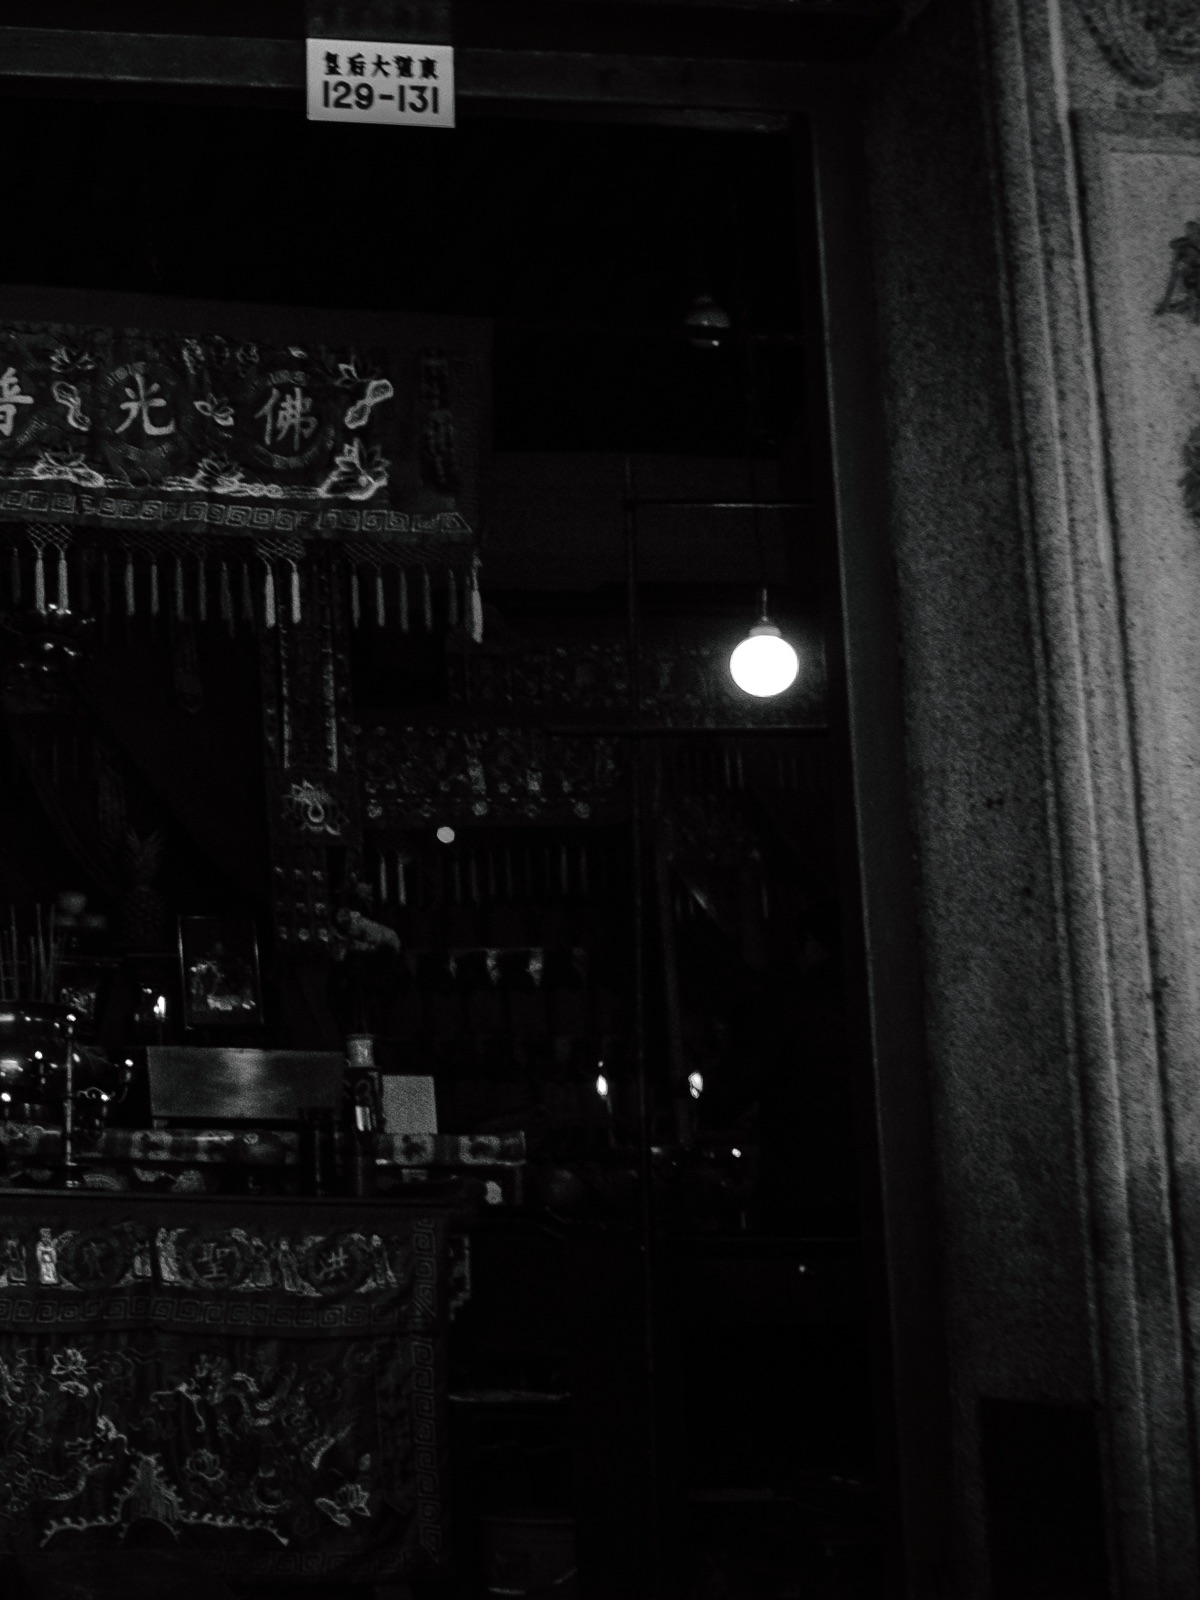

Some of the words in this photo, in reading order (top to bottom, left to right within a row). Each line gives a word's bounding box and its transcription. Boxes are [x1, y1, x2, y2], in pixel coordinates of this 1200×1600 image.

[323, 51, 438, 79] 皇后大道東
[323, 80, 439, 114] 129-131
